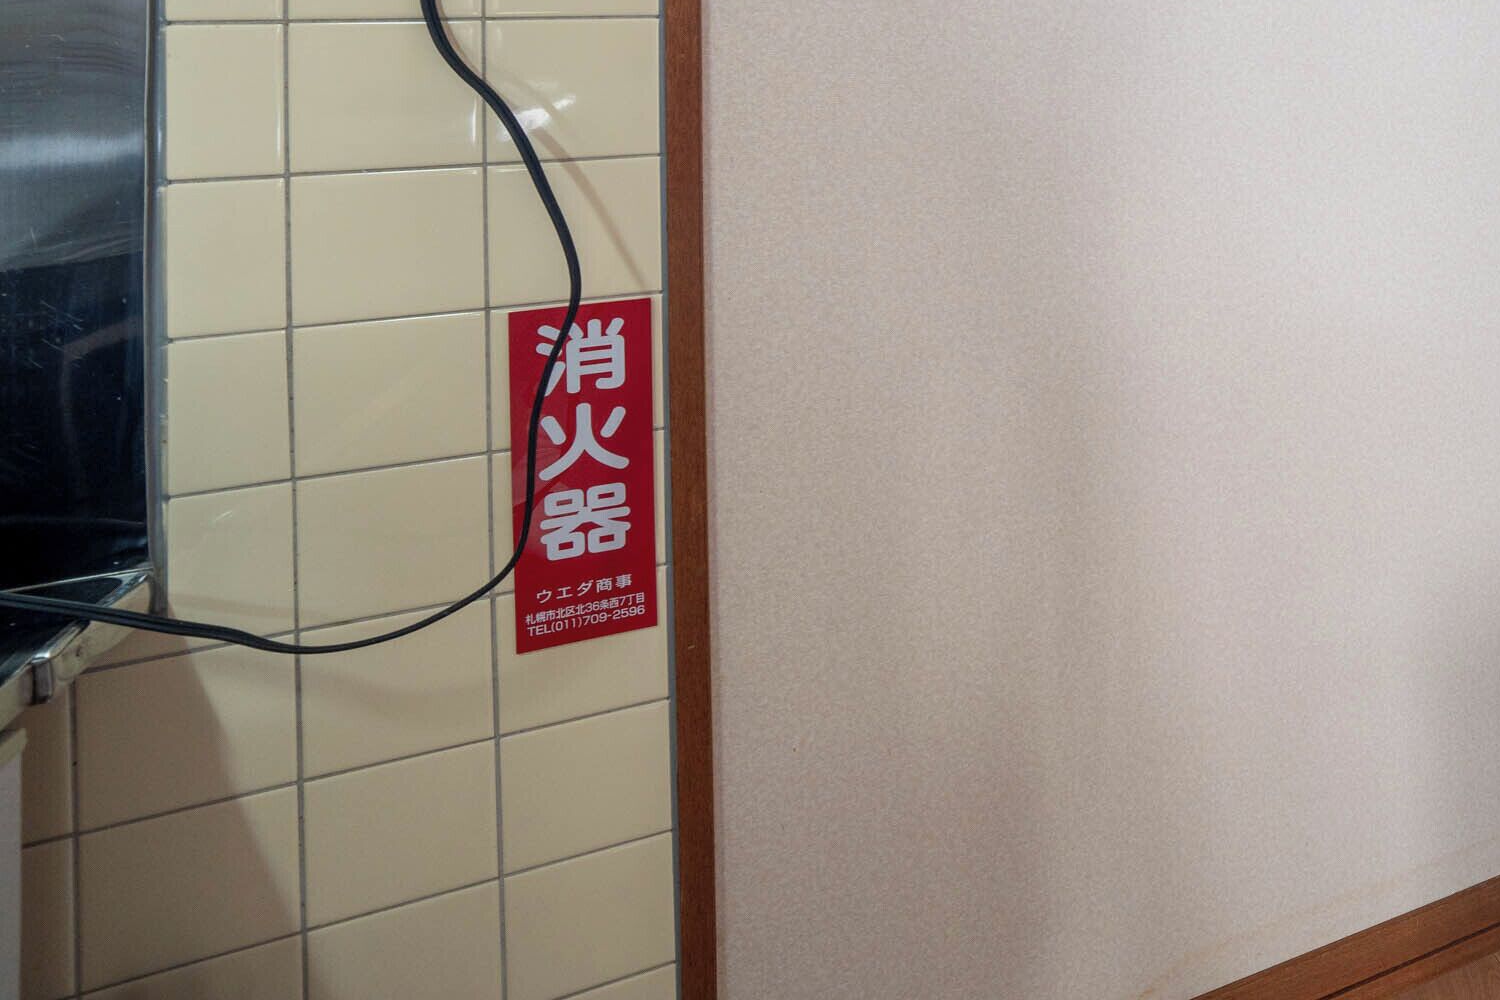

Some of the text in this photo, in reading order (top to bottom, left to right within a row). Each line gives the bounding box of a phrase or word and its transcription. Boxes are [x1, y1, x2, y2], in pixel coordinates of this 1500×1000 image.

[537, 317, 631, 561] 消火器
[536, 573, 632, 604] ウエダ商事
[525, 592, 645, 626] 札幌市北区北36条西7丁目
[527, 605, 645, 637] TEL(011)709-2596
